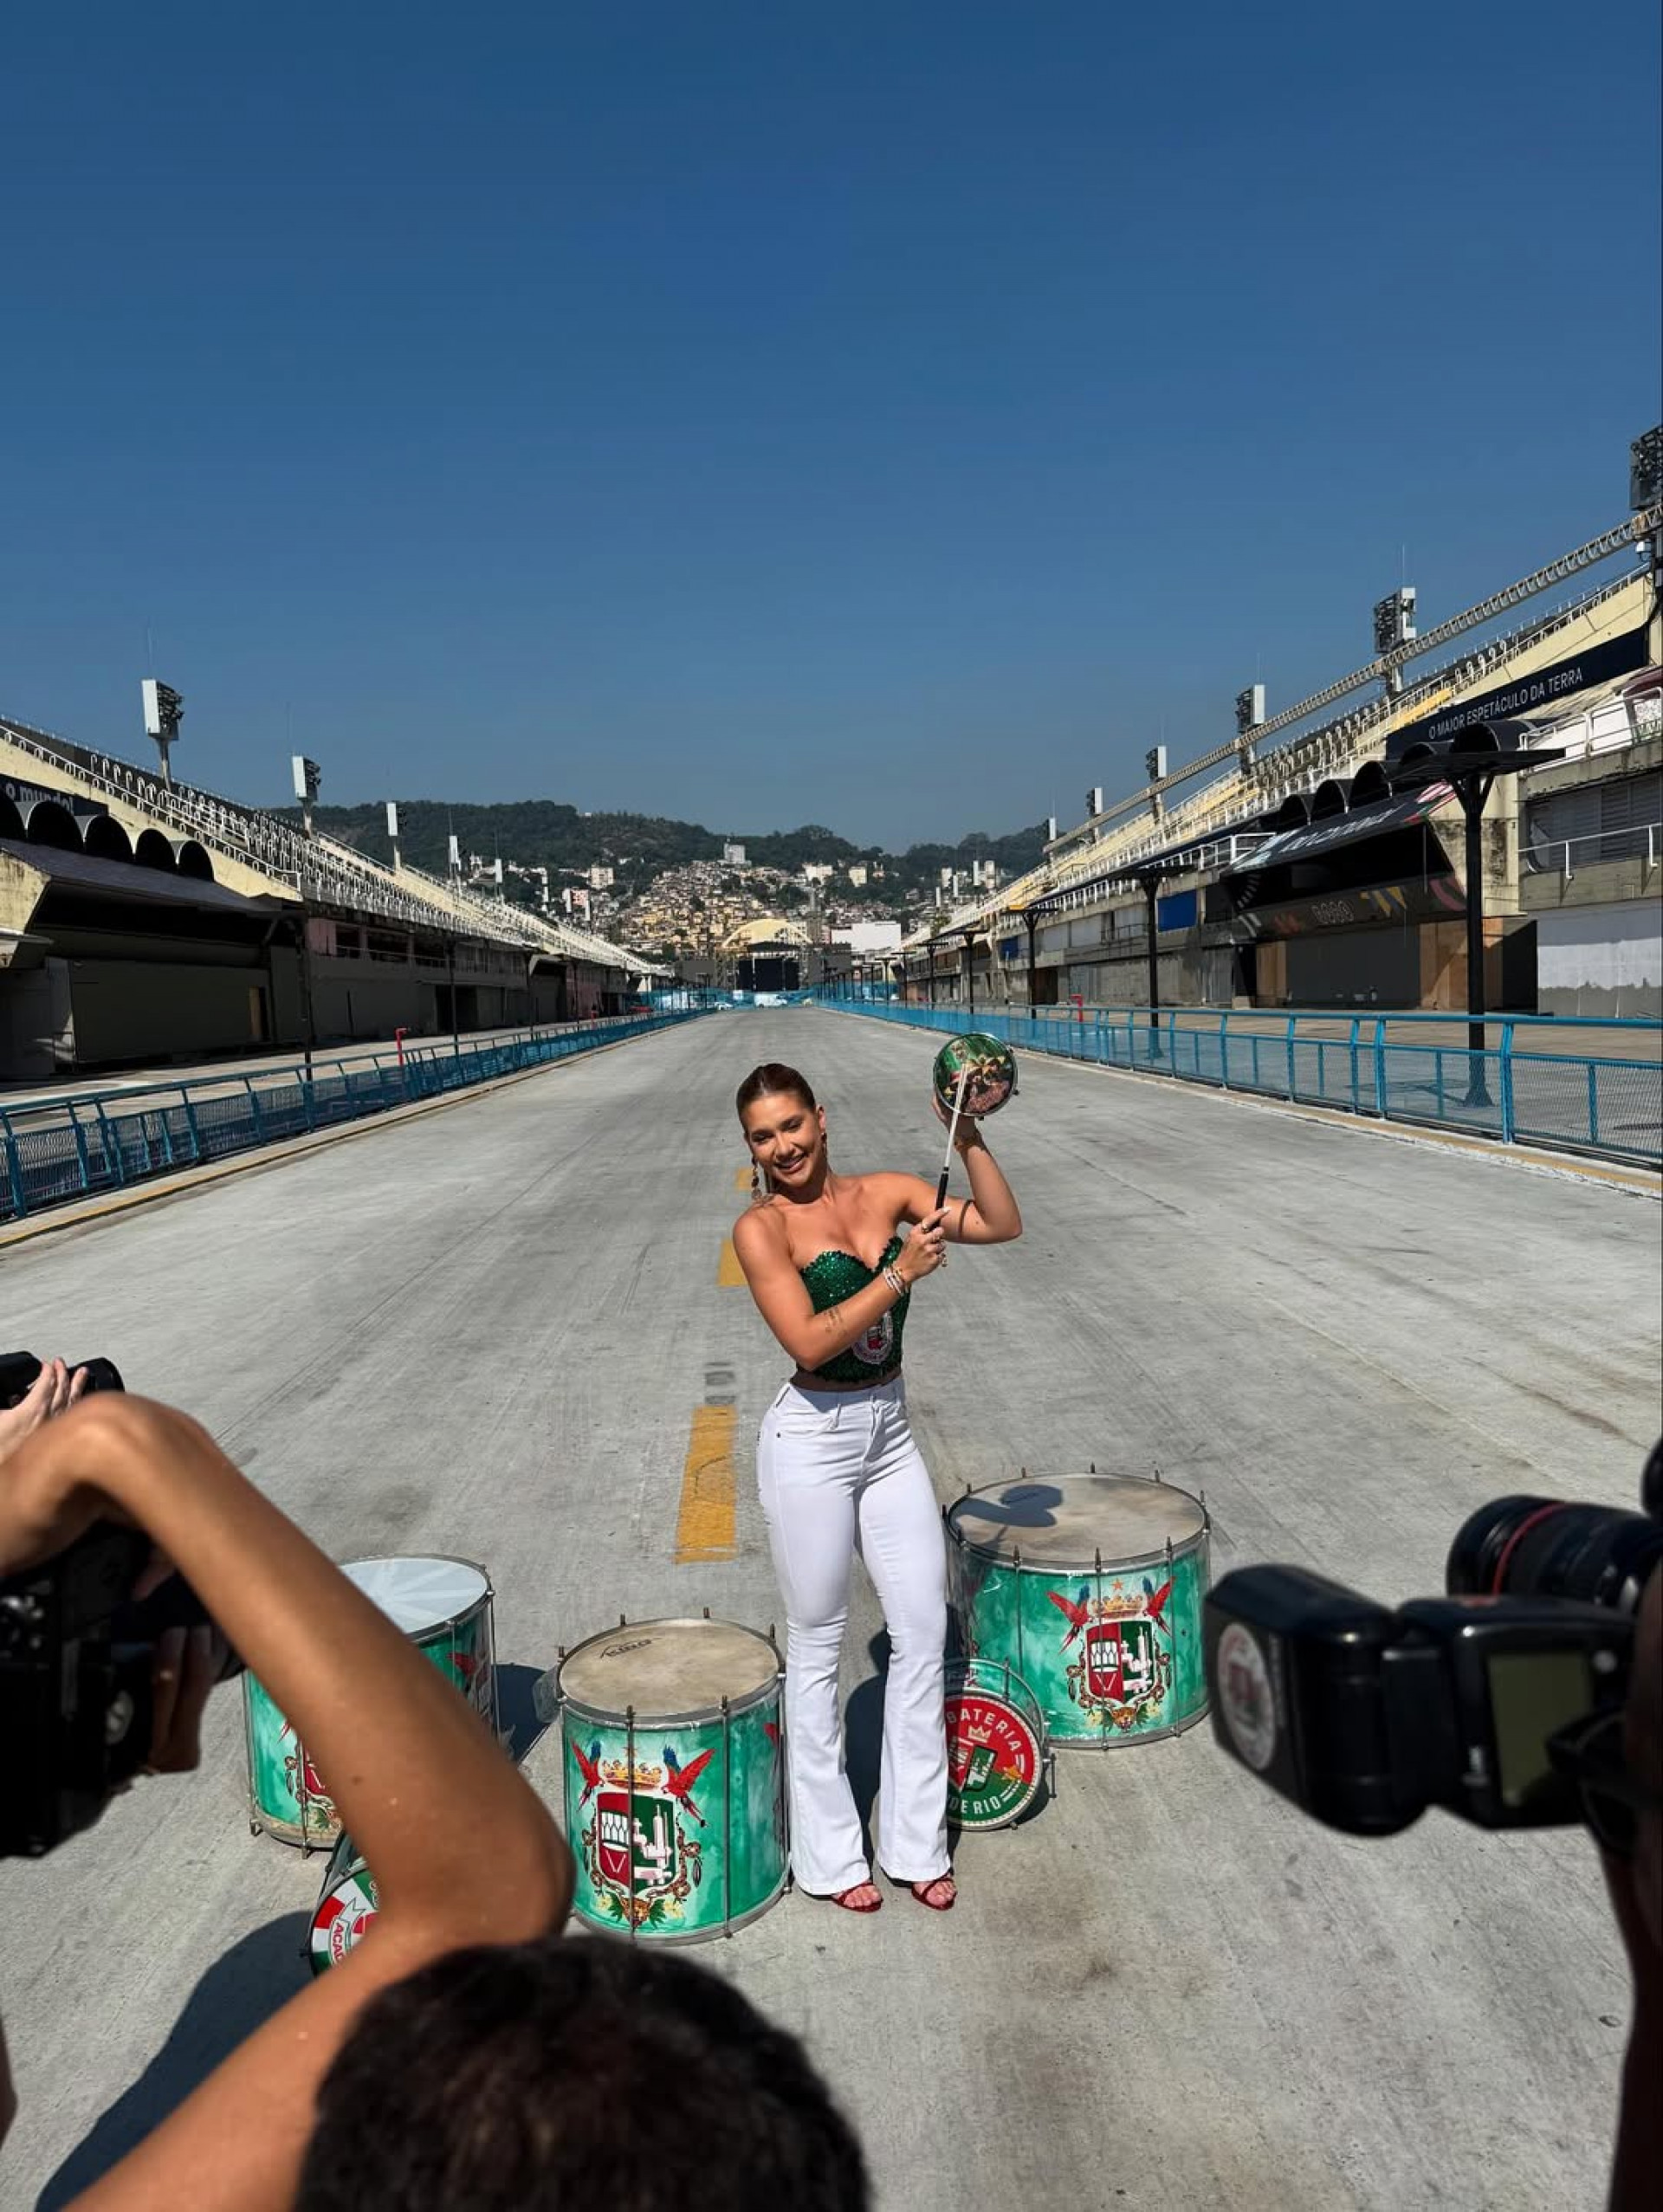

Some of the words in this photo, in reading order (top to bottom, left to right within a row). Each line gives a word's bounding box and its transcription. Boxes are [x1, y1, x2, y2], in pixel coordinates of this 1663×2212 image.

[1428, 726, 1436, 740] O
[1438, 714, 1466, 736] MAIOR
[1467, 689, 1529, 726] ESPETÁCULO
[1530, 682, 1545, 702] DA
[1548, 667, 1584, 694] TERRA
[946, 1707, 1023, 1752] BATERIA
